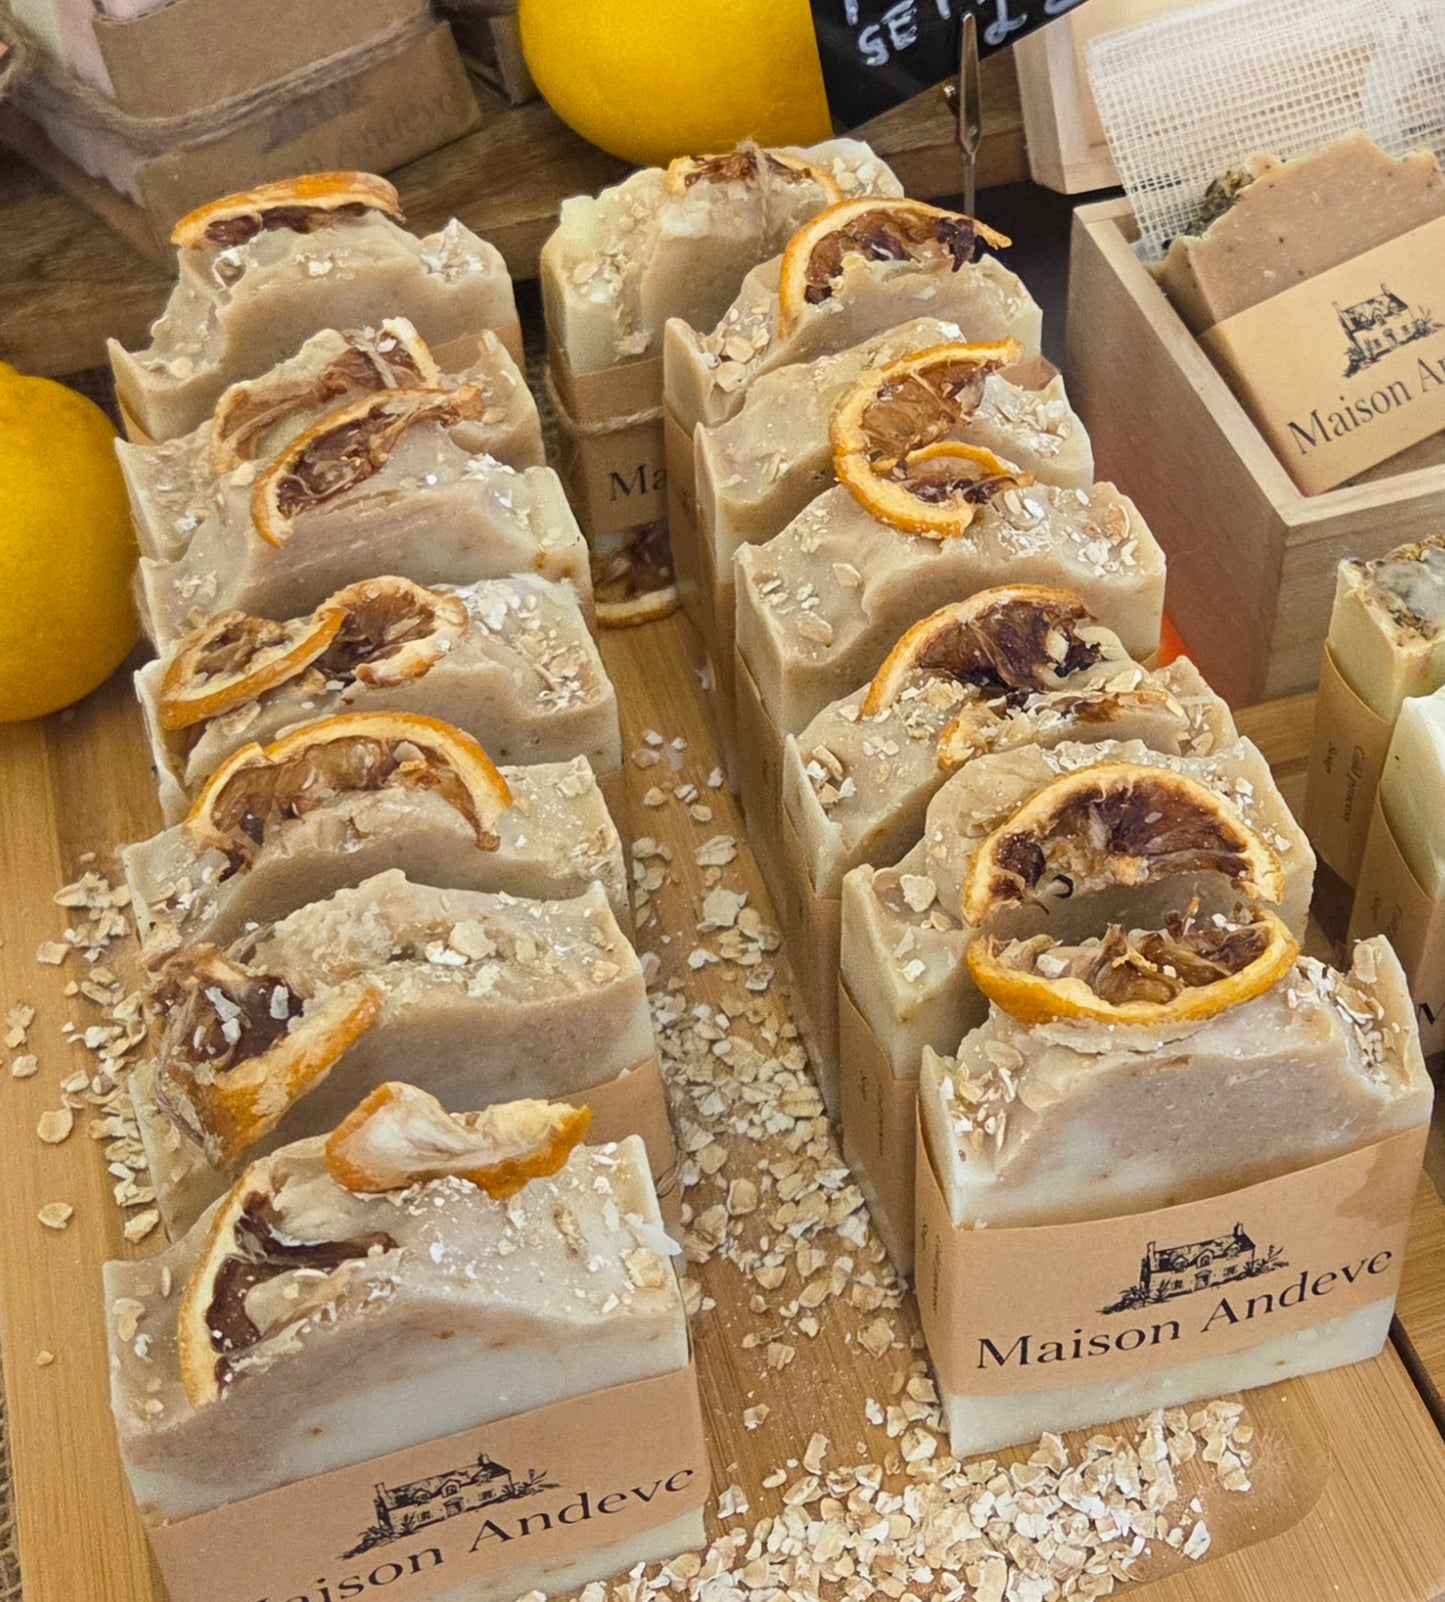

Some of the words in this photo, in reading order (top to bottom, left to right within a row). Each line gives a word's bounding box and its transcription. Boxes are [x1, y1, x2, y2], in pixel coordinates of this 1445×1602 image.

[1286, 380, 1413, 455] Maison
[609, 463, 667, 502] Ma
[976, 1319, 1181, 1369] Maison
[1200, 1250, 1393, 1333] Andeve
